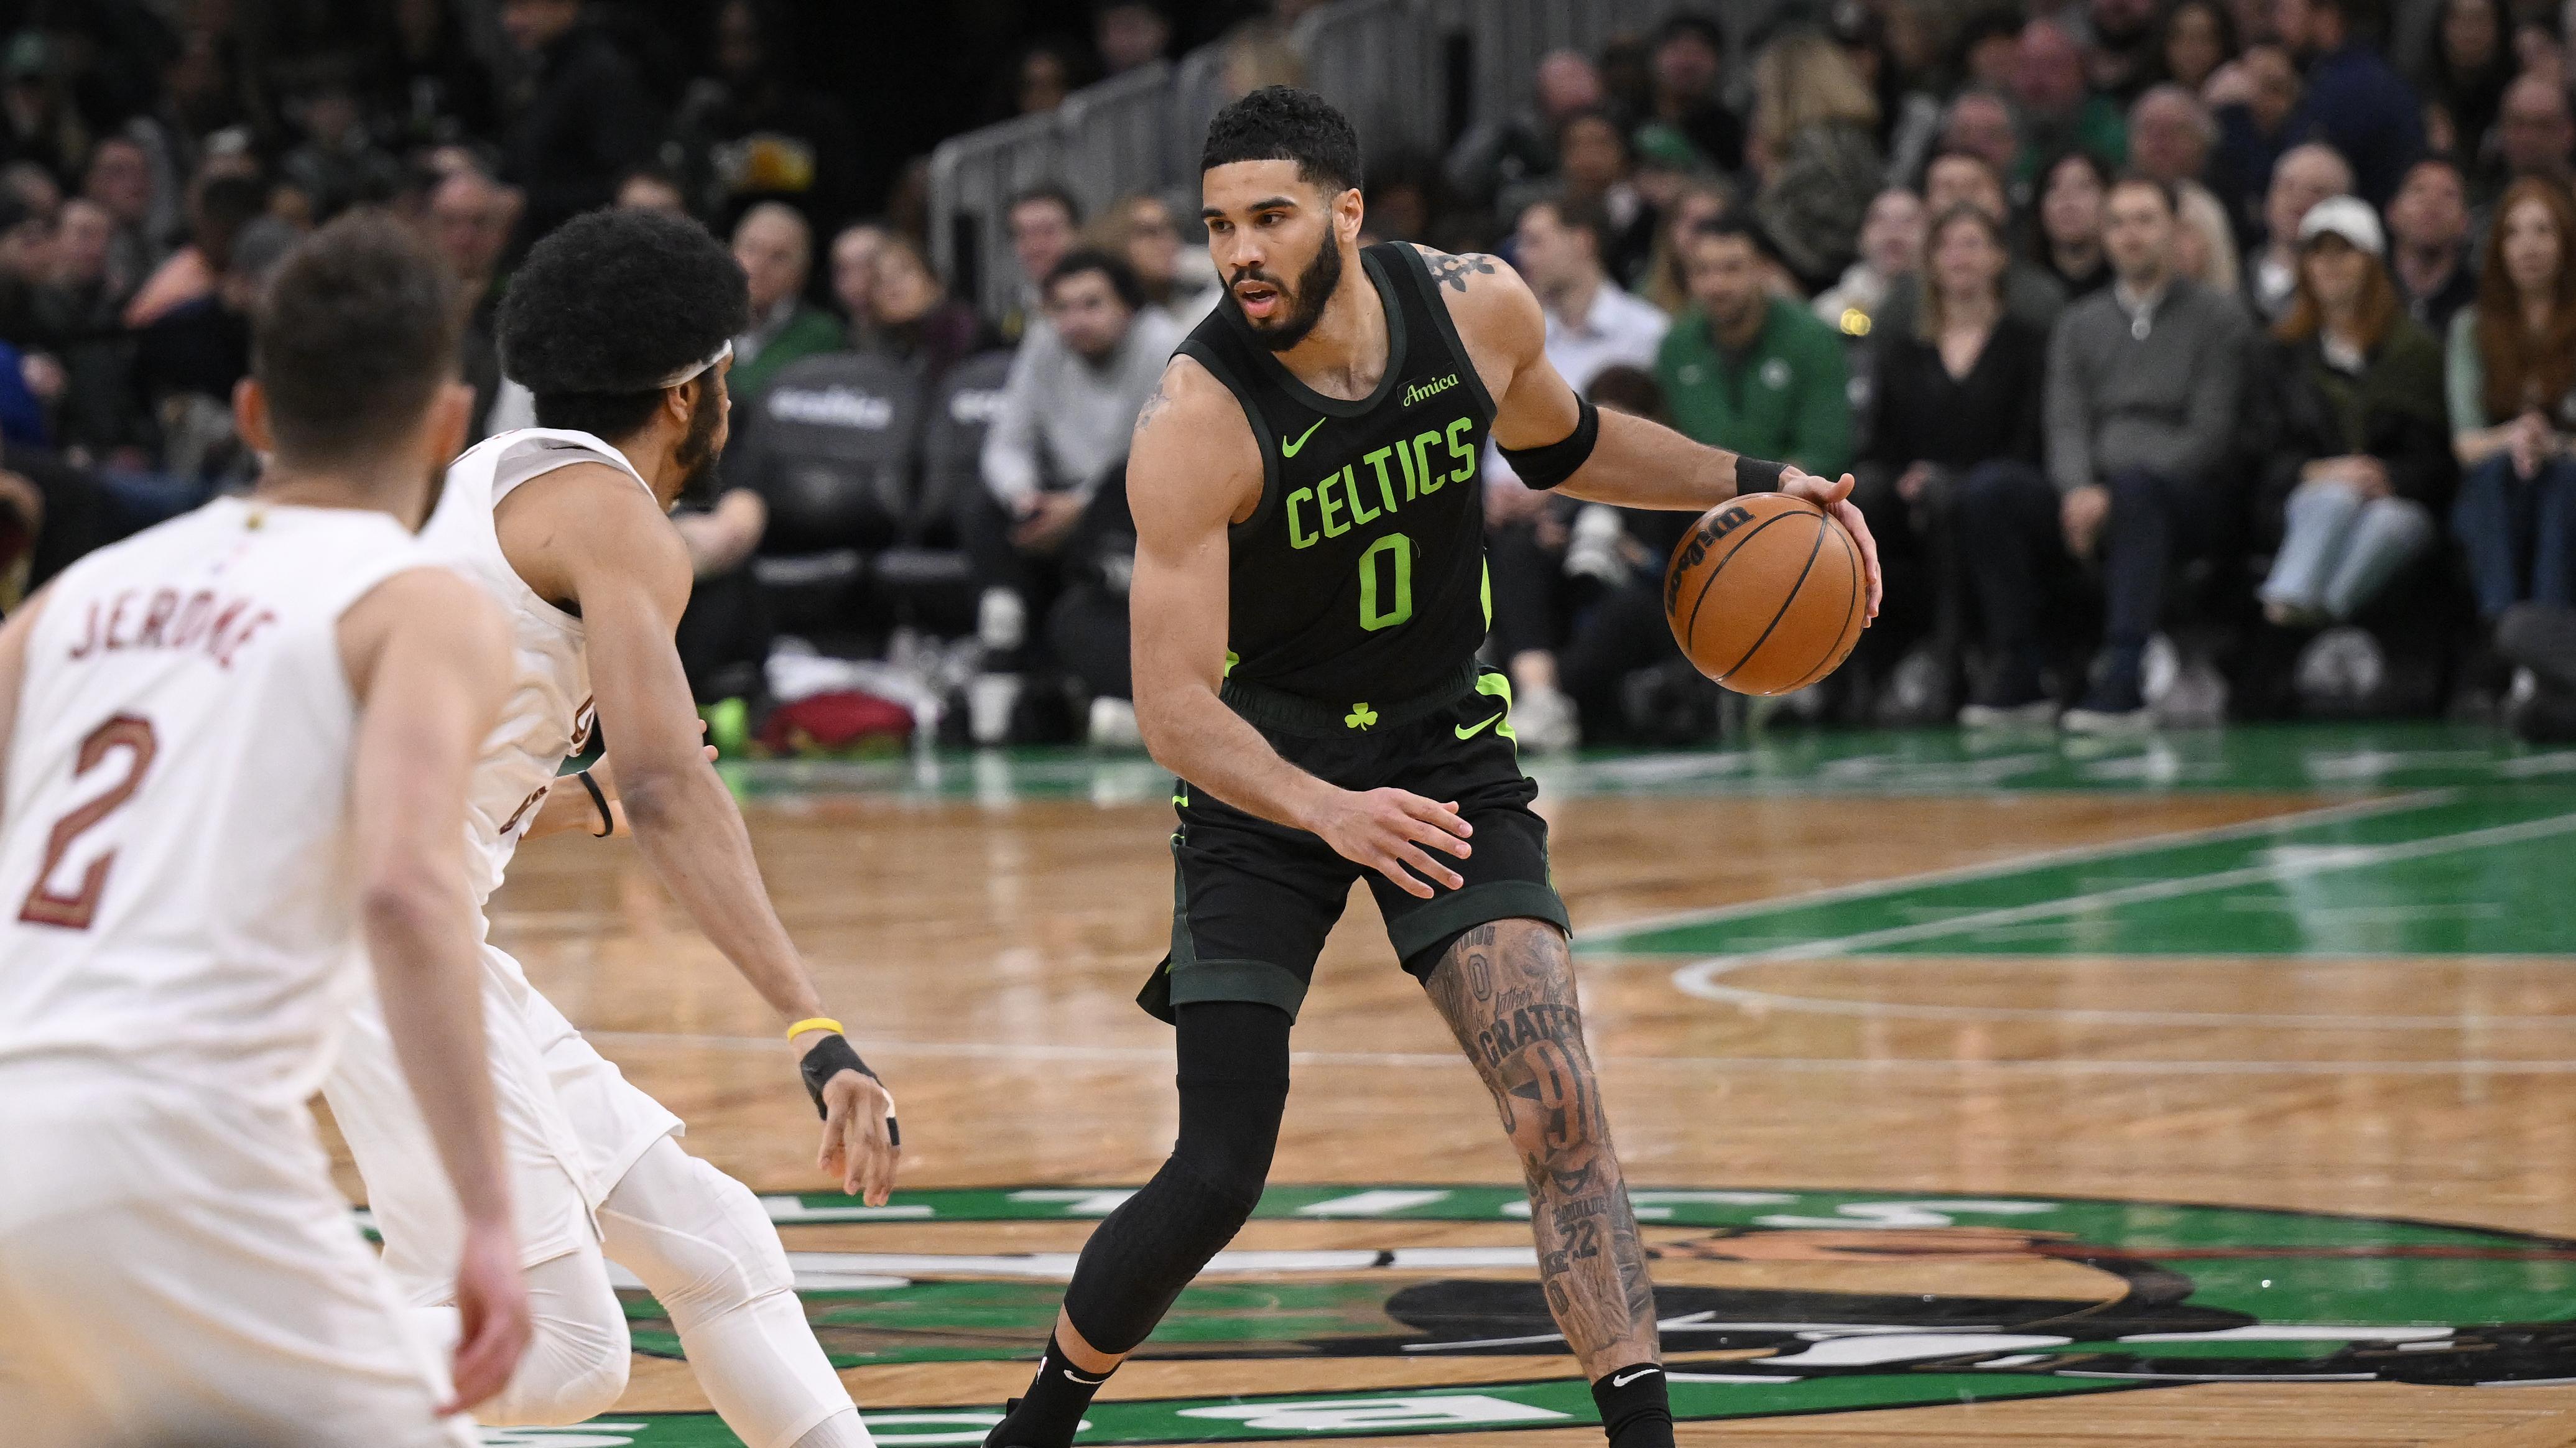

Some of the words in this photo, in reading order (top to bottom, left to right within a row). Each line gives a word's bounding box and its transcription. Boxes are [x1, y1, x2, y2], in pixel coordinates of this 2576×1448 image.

[1404, 373, 1459, 407] Amica
[1286, 417, 1475, 549] CELTICS
[1359, 532, 1412, 631] 0
[68, 586, 279, 671] JEROME
[17, 711, 157, 931] 2
[1559, 1219, 1598, 1260] 22
